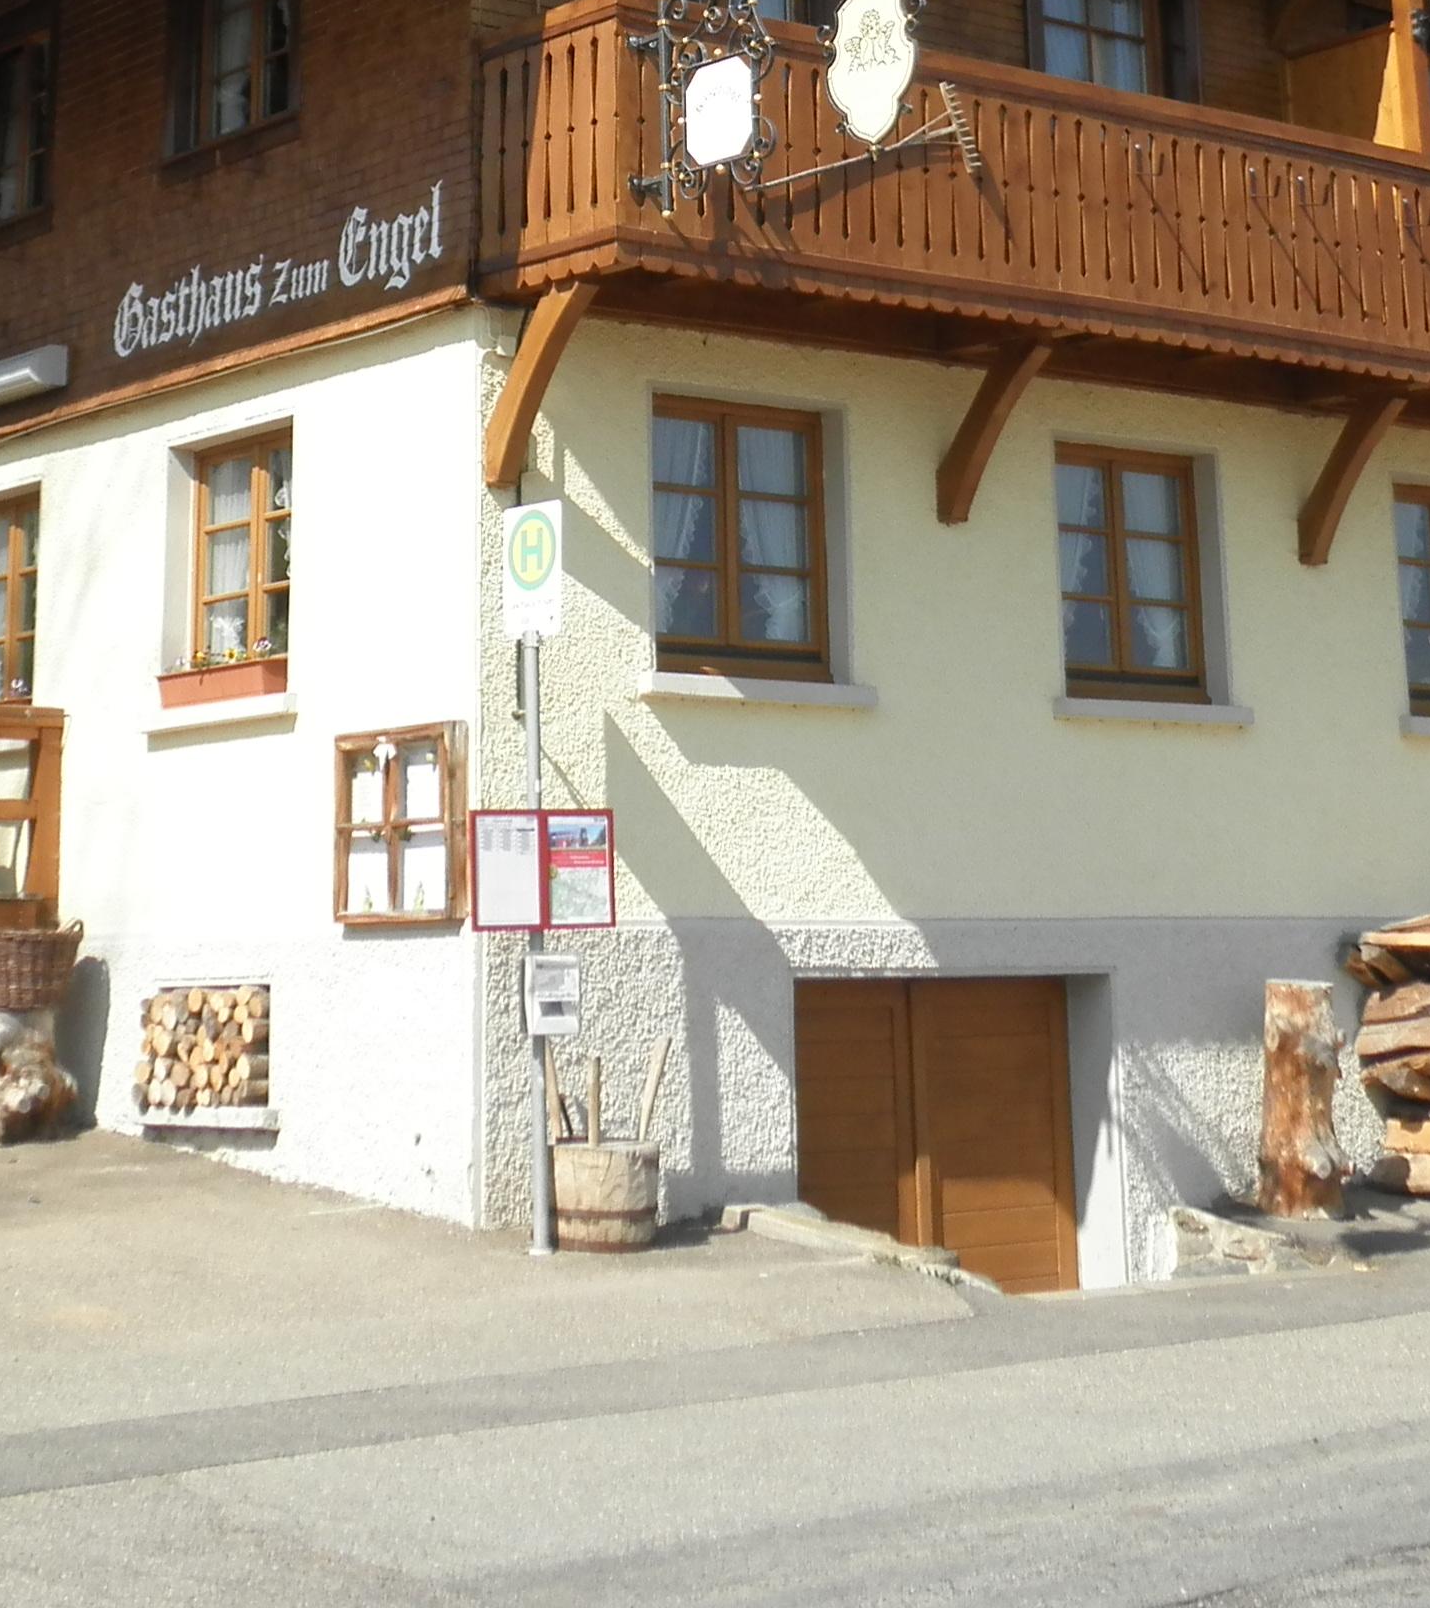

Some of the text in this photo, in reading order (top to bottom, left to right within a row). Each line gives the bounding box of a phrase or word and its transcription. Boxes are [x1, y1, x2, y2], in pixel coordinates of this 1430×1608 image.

[113, 253, 264, 358] Gasthaus
[337, 179, 444, 291] Engel
[520, 526, 543, 573] H
